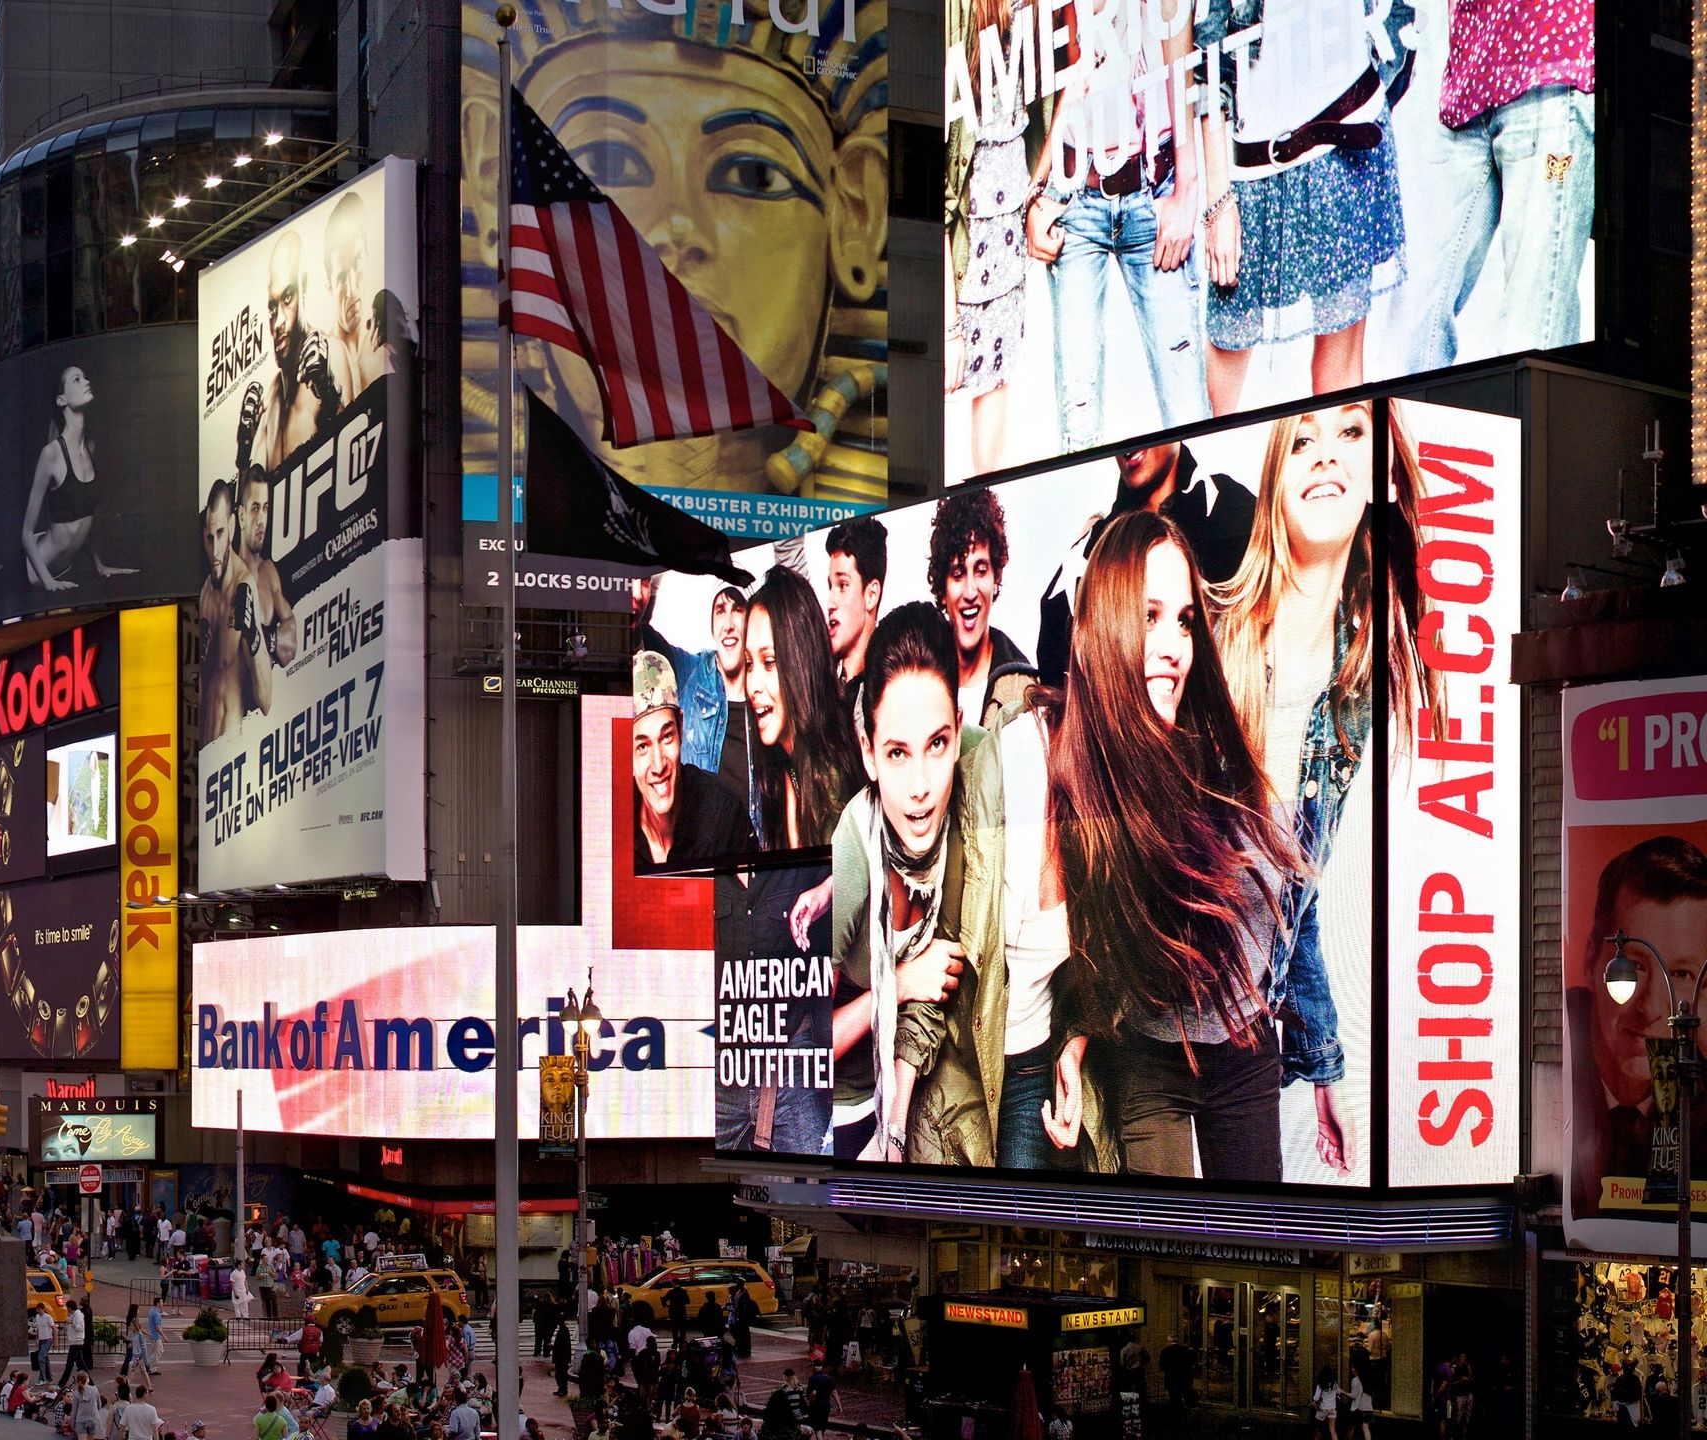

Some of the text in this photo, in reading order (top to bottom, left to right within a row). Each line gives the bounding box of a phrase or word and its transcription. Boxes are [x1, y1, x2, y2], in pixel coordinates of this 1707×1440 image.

[816, 59, 849, 71] NATIONAL
[816, 66, 858, 81] GEOGRAPHIC
[211, 304, 250, 371] SILVA
[205, 321, 264, 409] SONNEN
[324, 506, 379, 562] CAZADORES
[302, 587, 351, 652] FITCH
[328, 599, 385, 670] ALVES
[205, 659, 385, 824] SAT. AUGUST 7
[214, 805, 242, 847] LIVE
[245, 790, 265, 828] ON
[268, 714, 383, 815] PAY-PER-VIEW
[1416, 440, 1496, 1149] SHOP AE.COM
[125, 733, 172, 952] Kodak
[718, 1001, 789, 1044] EAGLE
[39, 1099, 158, 1112] MARQUIS
[540, 1112, 575, 1126] KING
[58, 1119, 91, 1144] Come
[110, 1122, 151, 1157] Away
[1094, 1232, 1295, 1264] AMERICAN EAGLE OUTFITTERS
[1362, 1253, 1392, 1271] aerie
[1658, 1270, 1672, 1285] 21
[947, 1304, 1024, 1325] NEWSSTAND
[1065, 1308, 1140, 1329] NEWSSTAND
